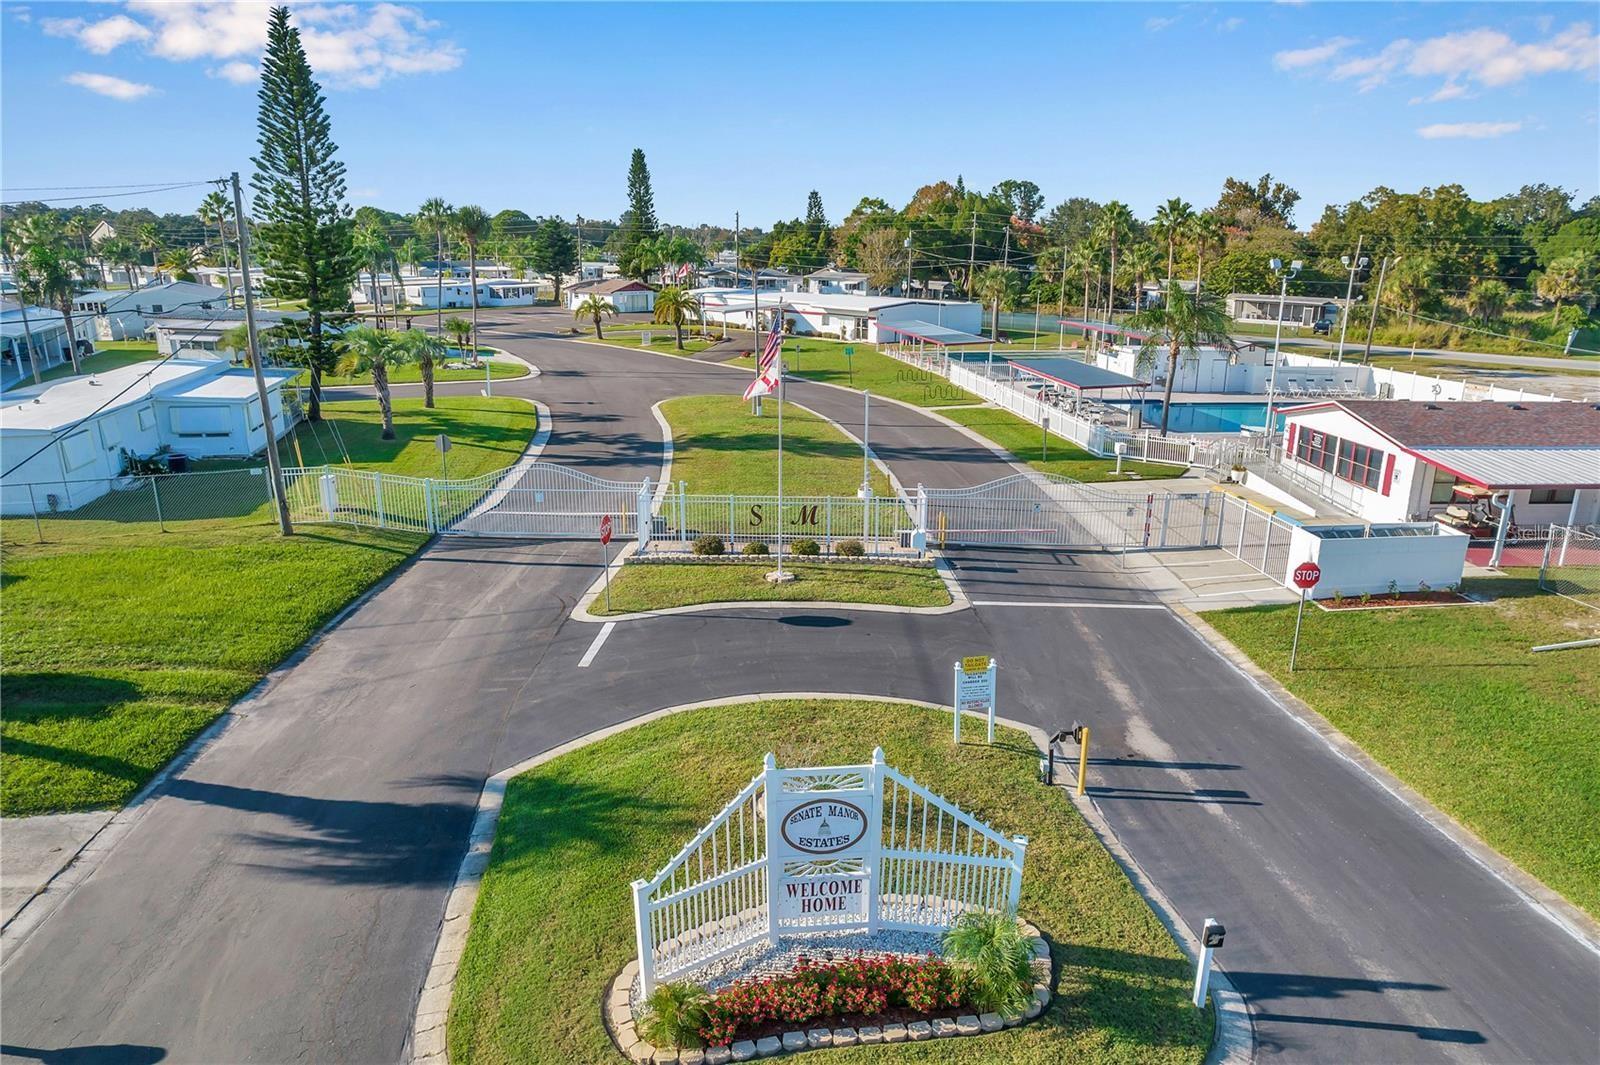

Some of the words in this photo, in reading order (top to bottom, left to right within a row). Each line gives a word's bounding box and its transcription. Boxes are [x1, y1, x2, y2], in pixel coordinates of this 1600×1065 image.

[750, 504, 763, 527] S
[790, 504, 820, 526] M
[1294, 569, 1320, 581] STOP
[790, 805, 823, 825] SENATE
[827, 805, 860, 821] MANOR
[798, 834, 851, 848] ESTATES
[786, 879, 863, 898] WELCOME
[801, 896, 847, 913] HOME
